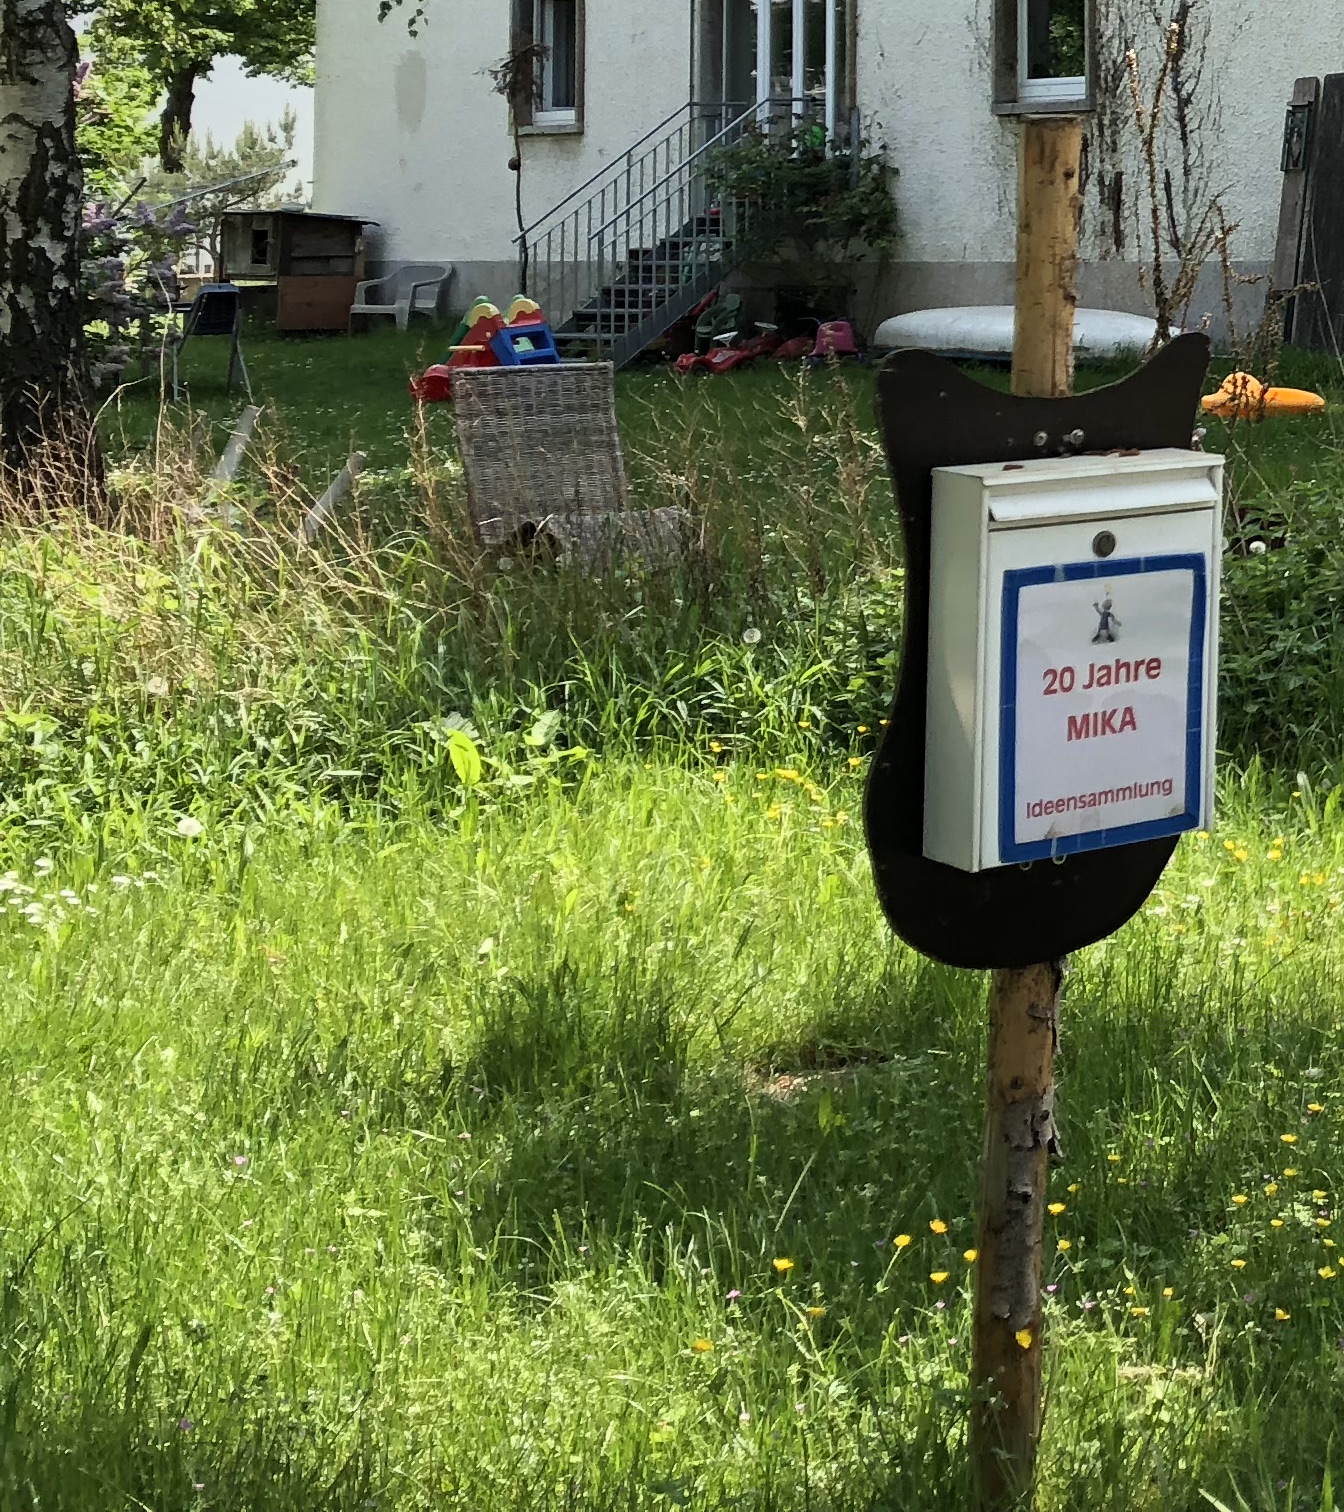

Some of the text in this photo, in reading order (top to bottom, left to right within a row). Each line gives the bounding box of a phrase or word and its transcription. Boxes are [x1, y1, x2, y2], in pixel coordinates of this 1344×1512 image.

[1043, 657, 1162, 696] 20 Jahre
[1067, 705, 1138, 742] MIKA
[1026, 777, 1173, 819] Ideensammlung
